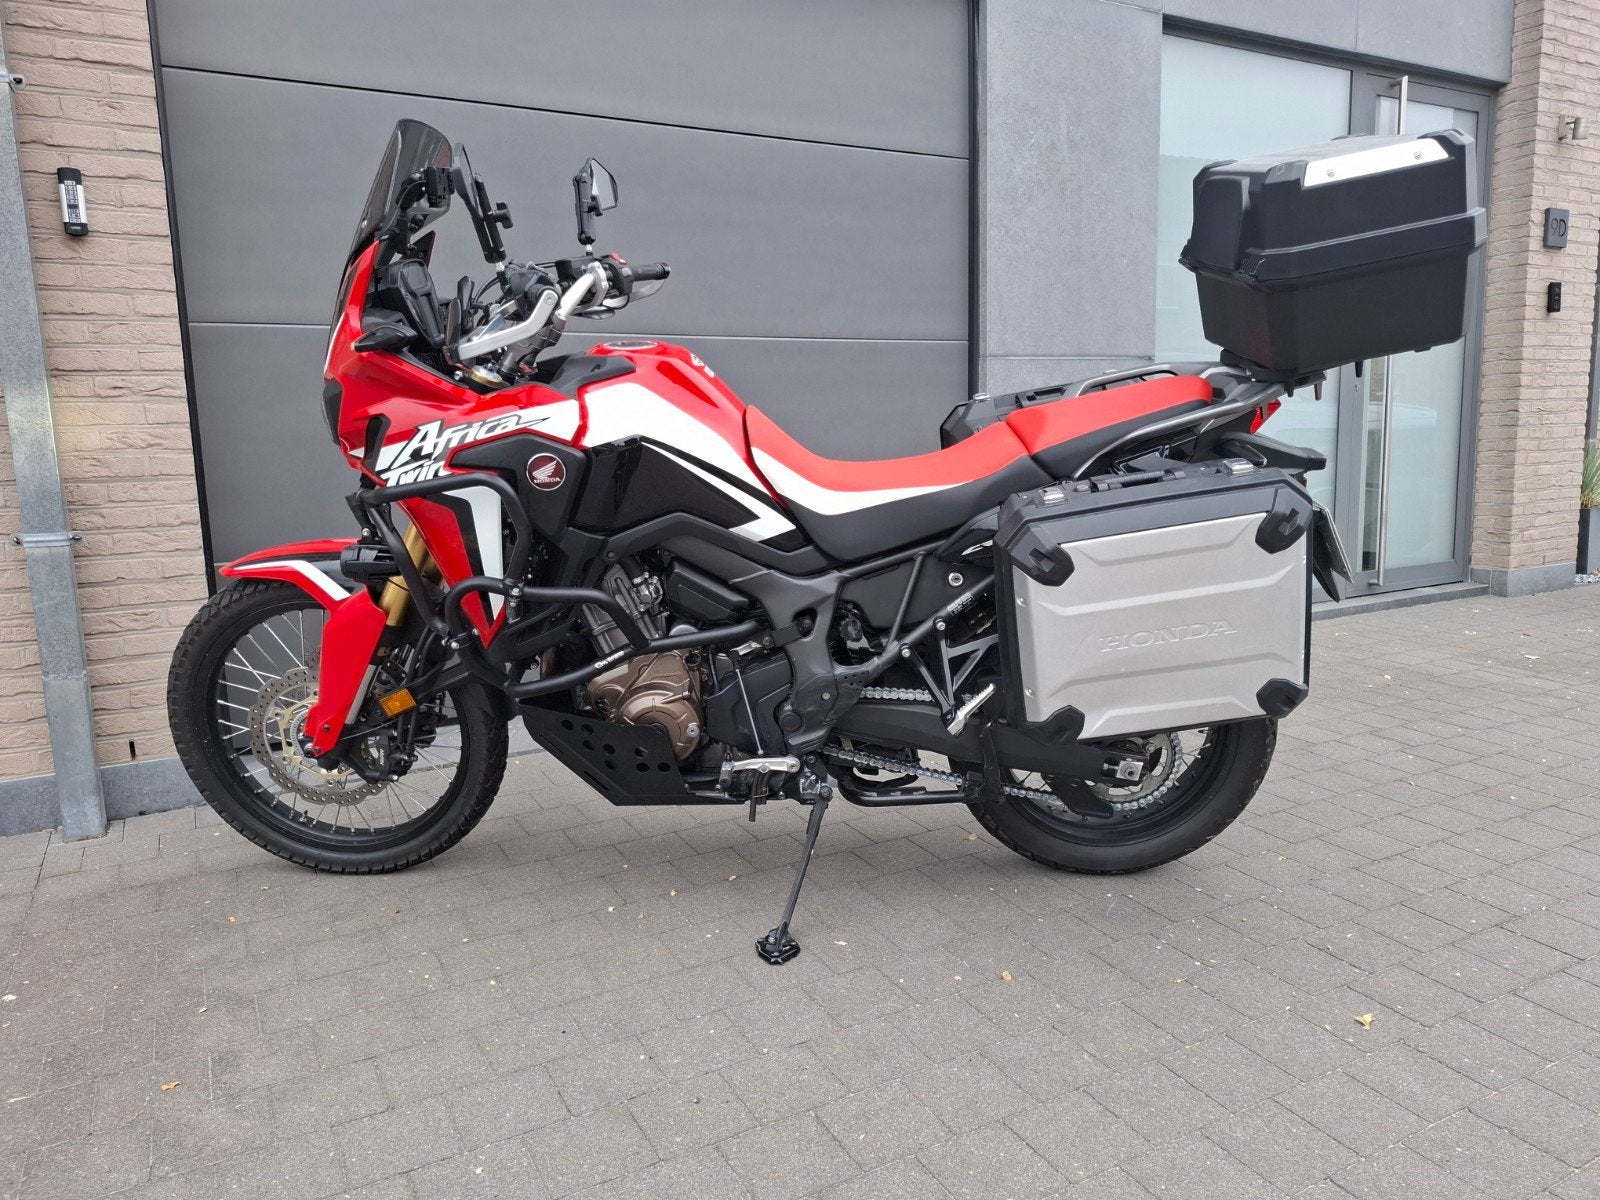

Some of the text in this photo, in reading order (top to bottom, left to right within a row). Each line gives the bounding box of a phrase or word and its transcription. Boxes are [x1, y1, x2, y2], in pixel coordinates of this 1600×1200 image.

[1551, 217, 1567, 238] 9D
[390, 414, 551, 470] Africa
[379, 459, 452, 488] Twin
[1099, 619, 1237, 653] HONDA
